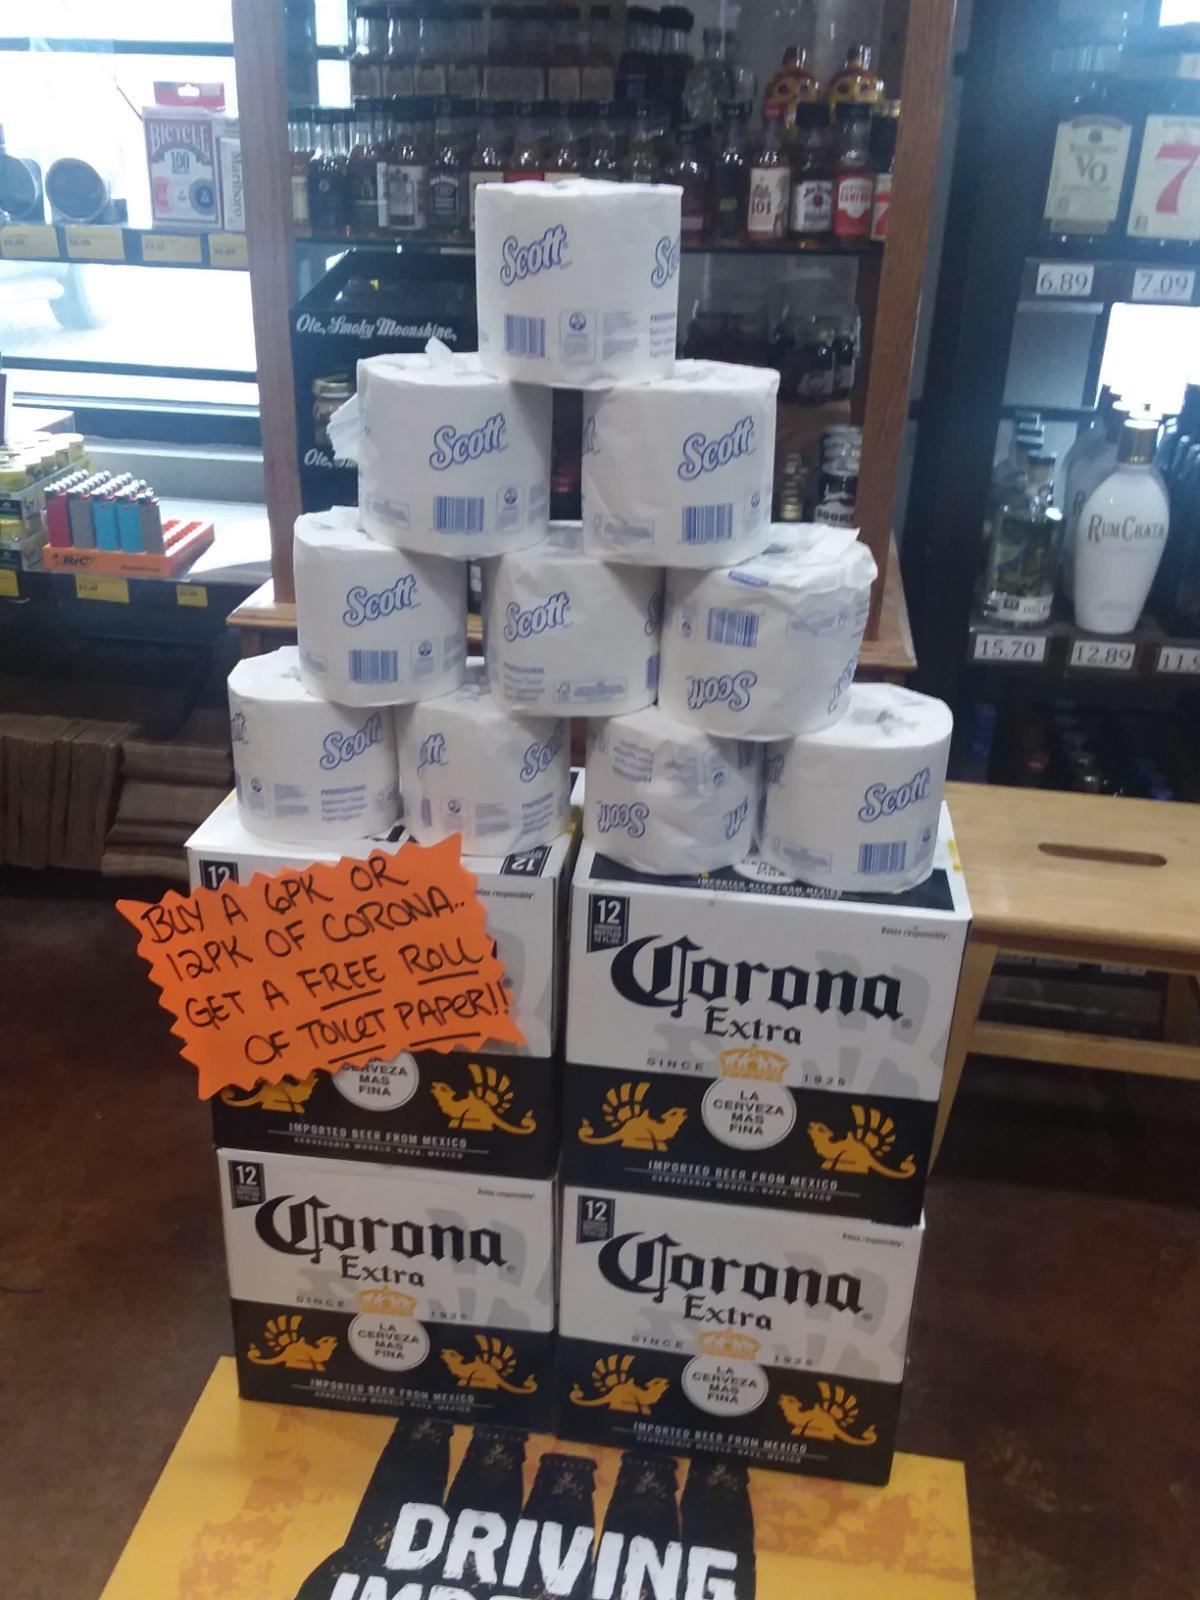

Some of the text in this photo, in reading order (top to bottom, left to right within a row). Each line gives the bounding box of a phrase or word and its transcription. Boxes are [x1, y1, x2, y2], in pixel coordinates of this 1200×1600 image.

[150, 121, 210, 156] BICYCLE
[171, 151, 190, 170] 100
[1154, 143, 1200, 214] 7
[501, 223, 568, 286] Scott
[1040, 271, 1089, 290] 6.89
[1140, 273, 1189, 296] 7.09
[328, 315, 375, 340] Smoky
[429, 412, 506, 471] Scott
[677, 415, 755, 481] Scott
[343, 574, 417, 628] Scott
[503, 591, 571, 642] Scott
[982, 638, 1036, 658] 15.70
[687, 669, 758, 712] Scott
[320, 713, 382, 770] Scott
[858, 767, 930, 823] Scott
[597, 802, 650, 838] Scott
[141, 856, 409, 944] BUY A 6PK OR
[597, 899, 621, 924] 12
[166, 935, 254, 982] 12PK
[265, 919, 305, 957] OF
[185, 991, 245, 1030] GET
[262, 979, 290, 1011] A
[296, 954, 386, 998] FREE
[611, 935, 904, 1022] Corona
[704, 1007, 801, 1044] Extra
[244, 1030, 290, 1065] OF
[647, 1057, 704, 1071] SINCE
[359, 1074, 390, 1086] MAS
[359, 1085, 391, 1097] FINA
[713, 1099, 785, 1116] CERVEZA
[740, 1090, 759, 1101] LA
[729, 1123, 764, 1136] FINA
[731, 1112, 765, 1124] MAS
[289, 1122, 467, 1149] IMPORTED BEER FROM MEXICO
[236, 1165, 257, 1185] 12
[648, 1160, 838, 1191] IMPORTED BEER FROM MEXICO
[585, 1200, 607, 1221] 12
[255, 1194, 507, 1266] Corona
[340, 1255, 425, 1287] Extra
[598, 1232, 864, 1314] Corona
[296, 1295, 345, 1307] SINCE
[684, 1294, 772, 1331] Extra
[357, 1330, 420, 1344] CERVEZA
[379, 1323, 397, 1332] LA
[632, 1335, 684, 1348] SINCE
[692, 1372, 757, 1388] CERVEZA
[716, 1366, 734, 1375] LA
[310, 1378, 475, 1403] IMPORTED BEER FROM MEXICO
[707, 1393, 739, 1404] FINA
[634, 1421, 807, 1453] IMPORTED BEER FROM MEXICO
[385, 1502, 738, 1600] DRIVING
